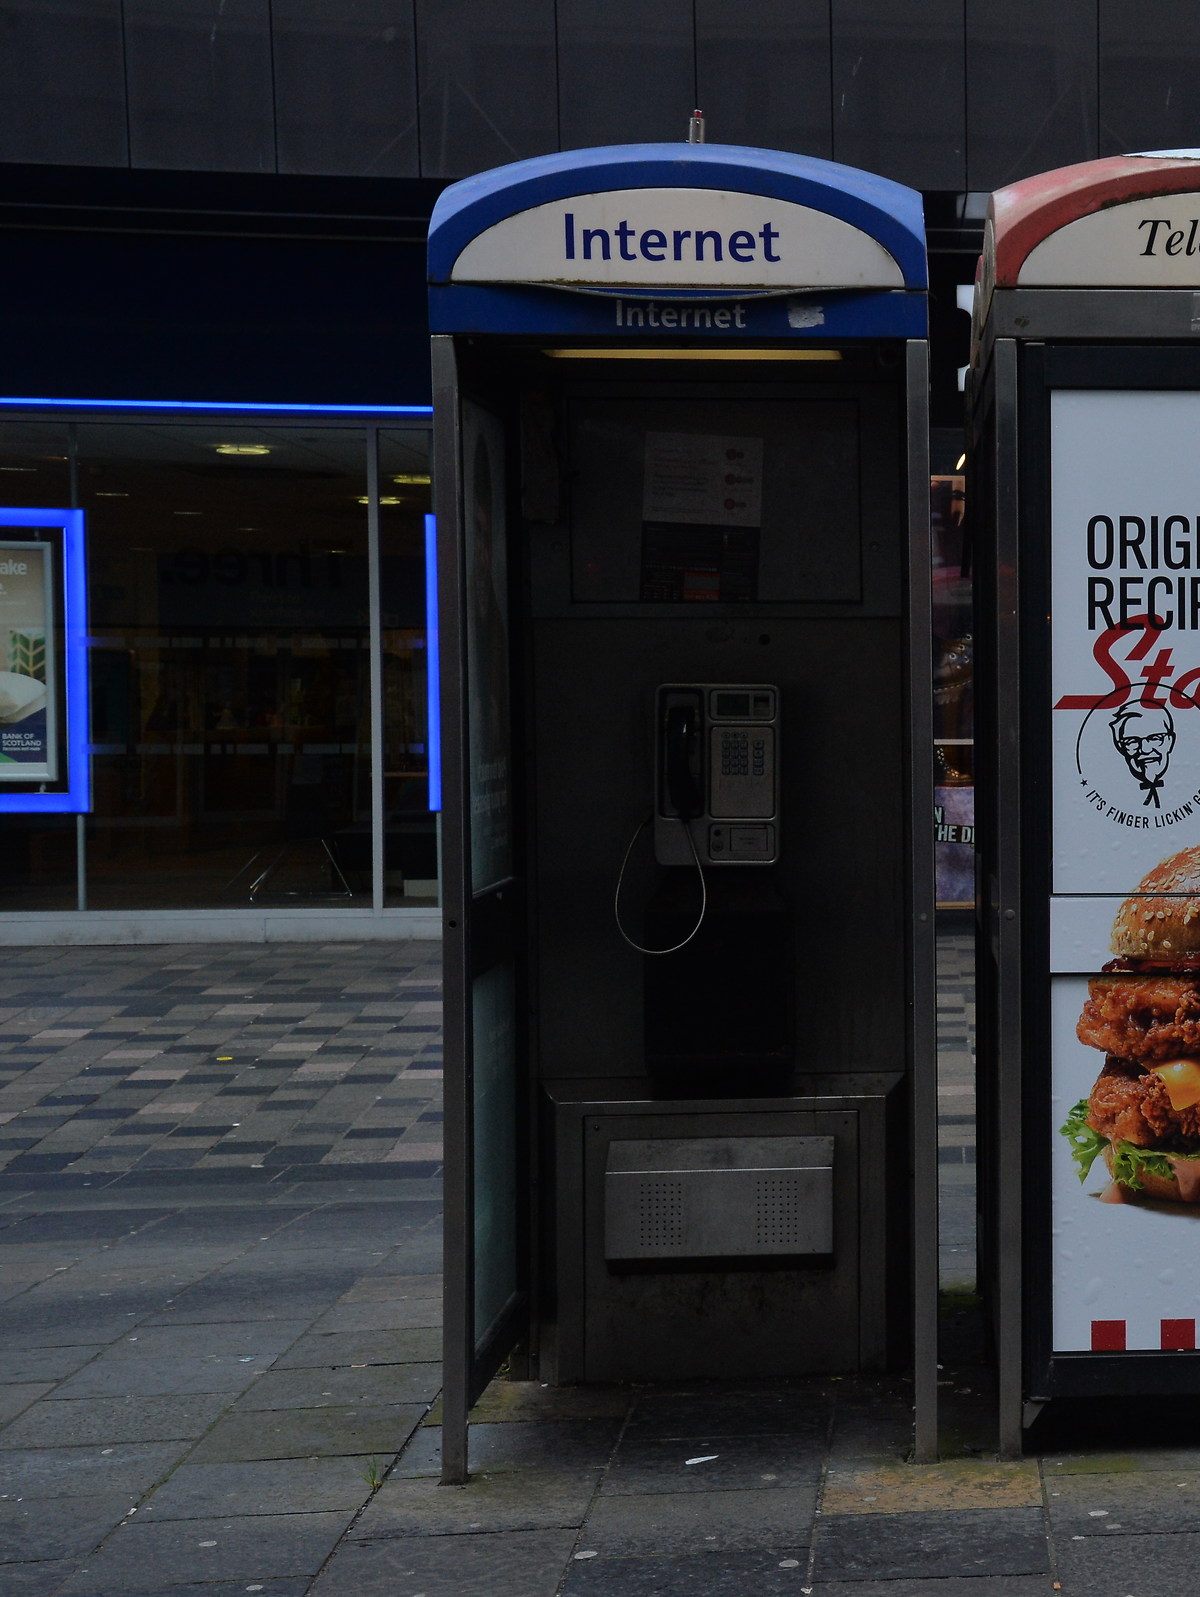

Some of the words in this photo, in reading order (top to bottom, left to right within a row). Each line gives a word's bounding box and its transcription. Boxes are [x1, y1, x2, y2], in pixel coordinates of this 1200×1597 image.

[564, 213, 781, 263] Internet
[616, 300, 748, 329] Internet
[1085, 790, 1107, 811] IT'S
[1106, 806, 1149, 829] FINGER
[1154, 801, 1194, 828] LICKIN'
